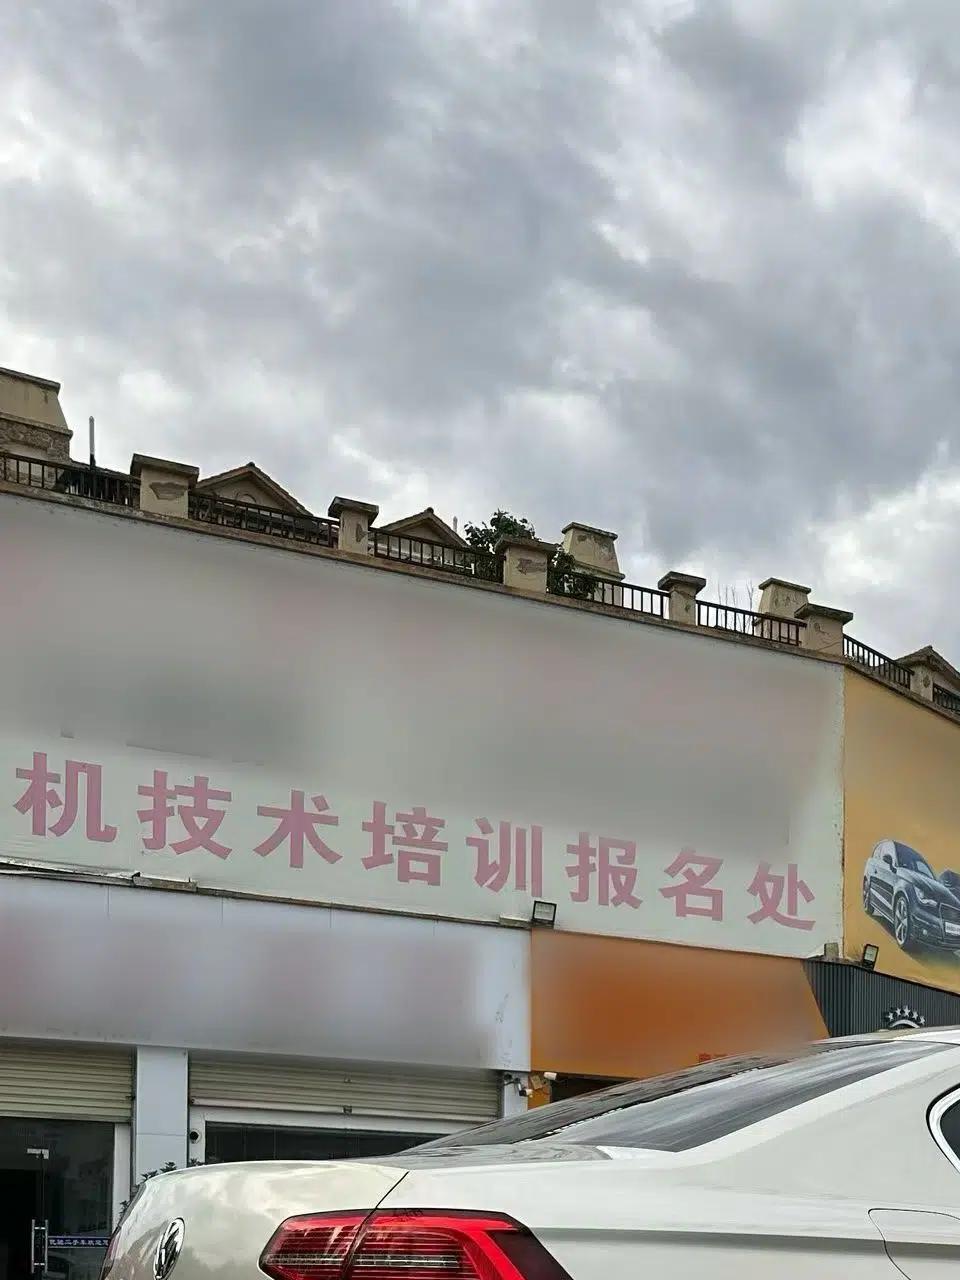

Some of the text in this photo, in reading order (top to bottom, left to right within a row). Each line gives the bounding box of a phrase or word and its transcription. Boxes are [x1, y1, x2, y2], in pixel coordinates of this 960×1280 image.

[15, 751, 818, 931] 机技术培训报名处
